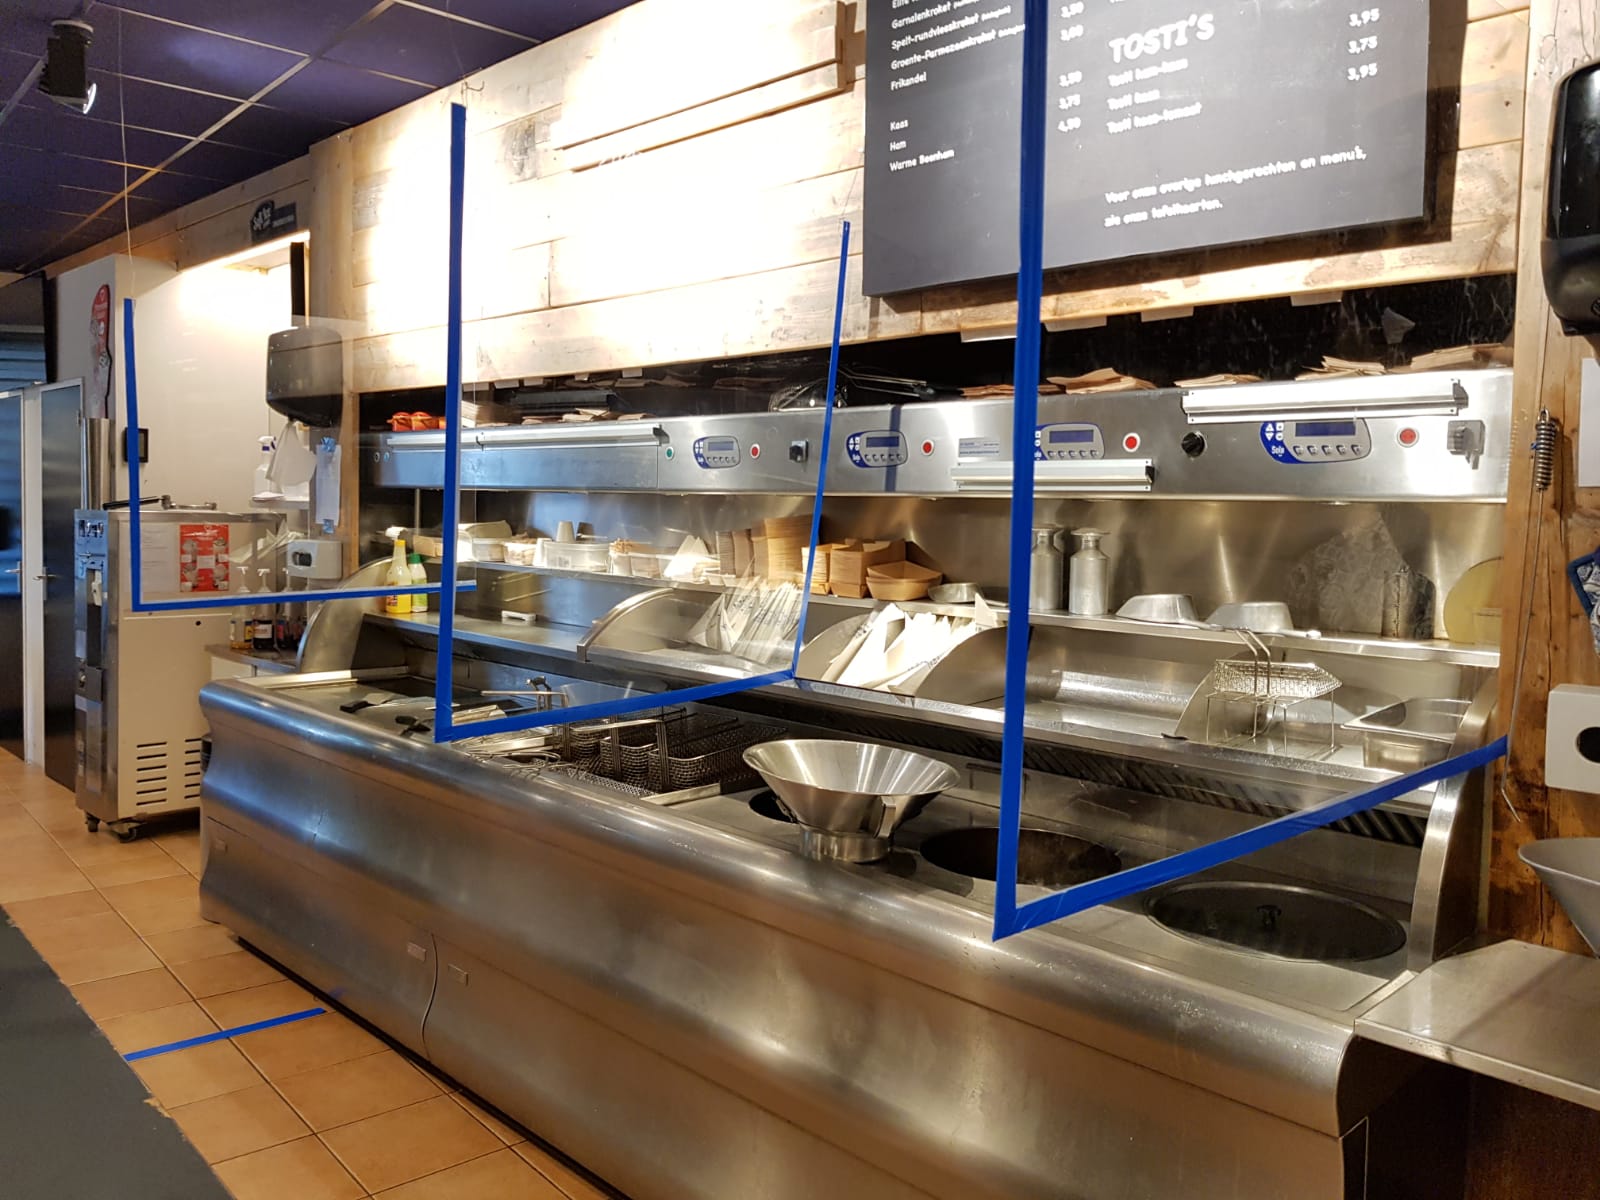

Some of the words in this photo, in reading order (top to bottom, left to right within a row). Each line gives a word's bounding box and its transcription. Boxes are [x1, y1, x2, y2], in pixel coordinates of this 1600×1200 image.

[891, 2, 952, 29] Garnalenkroket
[1349, 8, 1379, 27] 3,95
[891, 13, 980, 51] Spelt-rundvleeskroket
[1108, 13, 1215, 63] TOSTI'S
[1348, 35, 1378, 54] 3,75
[890, 71, 927, 91] Frikandel
[1347, 62, 1377, 81] 3,95
[890, 119, 908, 131] Kaas
[889, 140, 907, 151] Ham
[889, 157, 917, 172] Warme
[919, 149, 955, 165] Beenham
[1204, 160, 1297, 187] lunchgerechten
[1300, 156, 1316, 169] en
